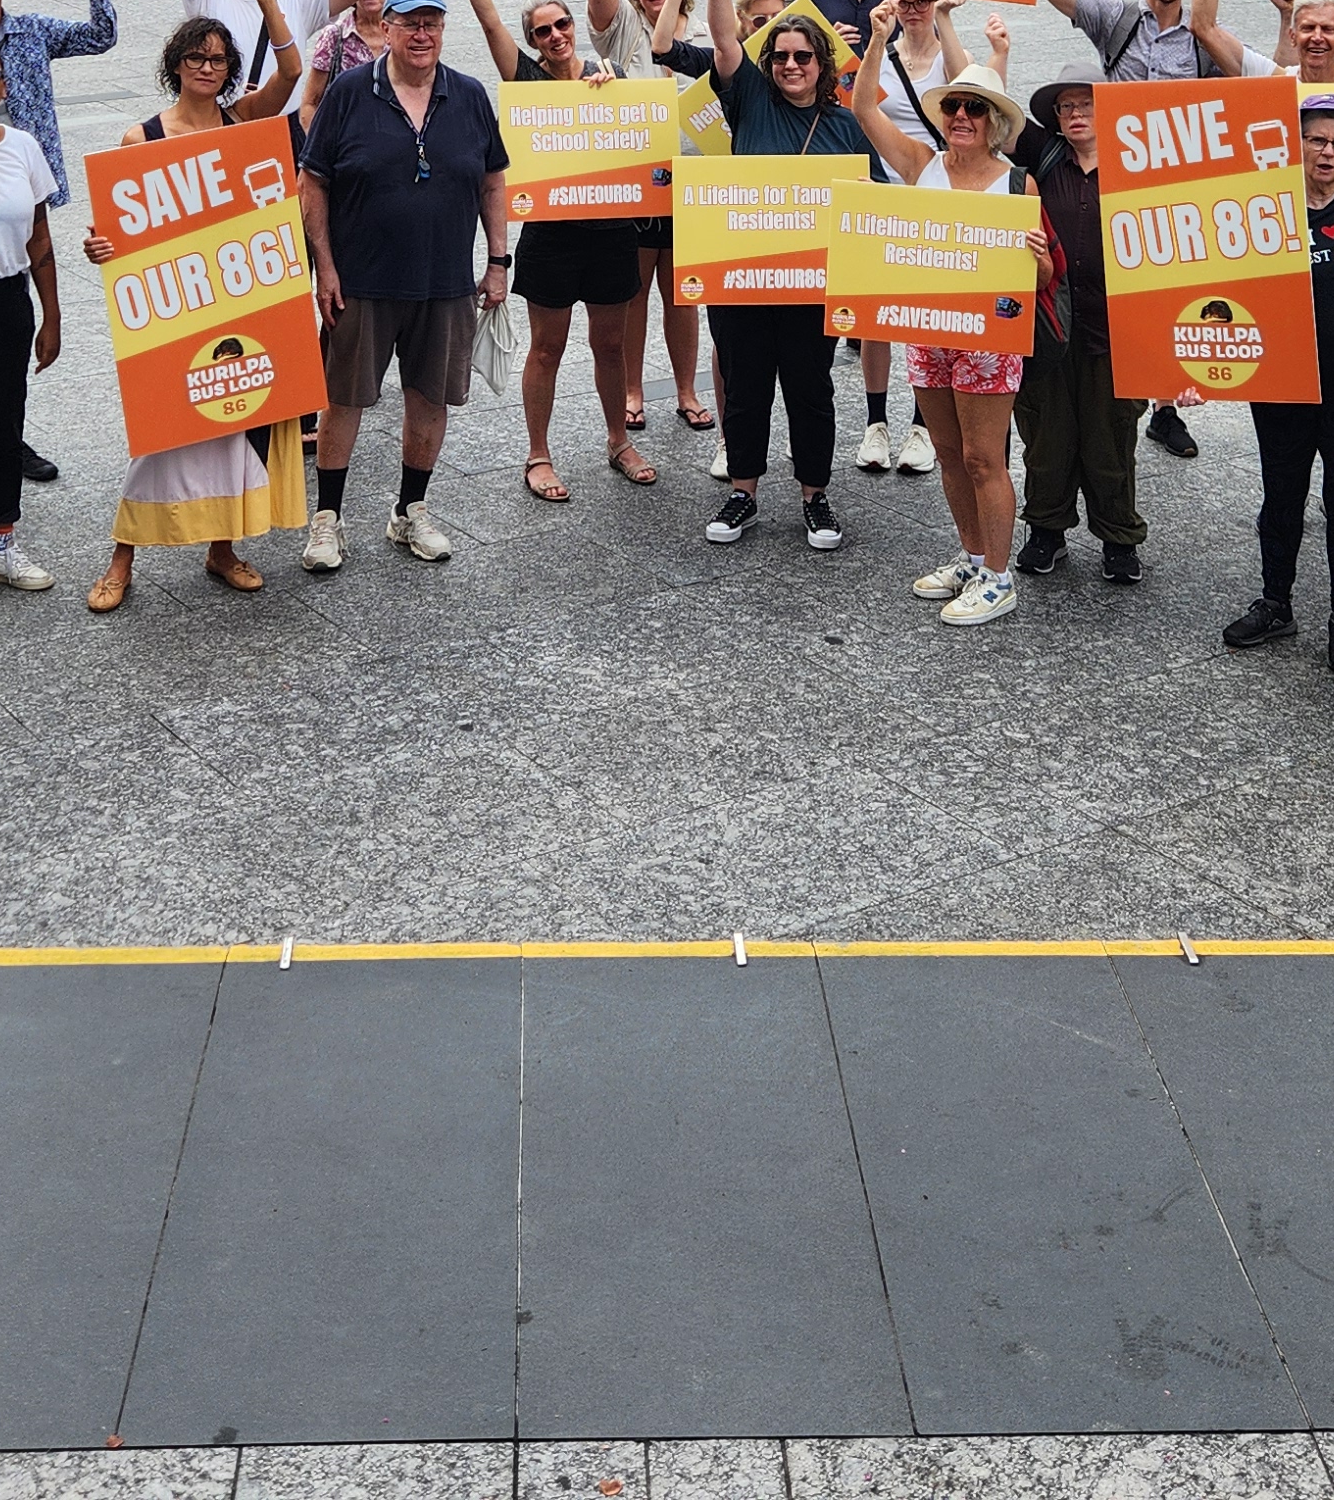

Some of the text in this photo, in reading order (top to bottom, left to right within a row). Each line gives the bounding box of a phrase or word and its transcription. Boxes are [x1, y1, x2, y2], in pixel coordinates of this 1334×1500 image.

[509, 104, 669, 129] Helping Kids get to
[530, 128, 650, 152] School Safely!
[1115, 99, 1234, 173] SAVE
[111, 149, 234, 236] SAVE
[548, 183, 643, 206] #SAVEOUR86
[682, 184, 788, 207] A Lifeline for
[726, 209, 816, 231] Residents!
[839, 212, 1027, 249] A Lifeline for Tangara
[1110, 193, 1301, 269] OUR 86!
[884, 242, 978, 272] Residents!
[114, 224, 302, 330] OUR 86!
[723, 268, 827, 289] #SAVEOUR86
[876, 304, 986, 335] #SAVEOUR86
[1173, 326, 1262, 343] KURILPA
[1174, 343, 1264, 359] BUS LOOP
[186, 353, 272, 388] KURILPA
[1207, 367, 1232, 381] 86
[188, 370, 275, 403] BUS LOOP
[223, 399, 247, 415] 86
